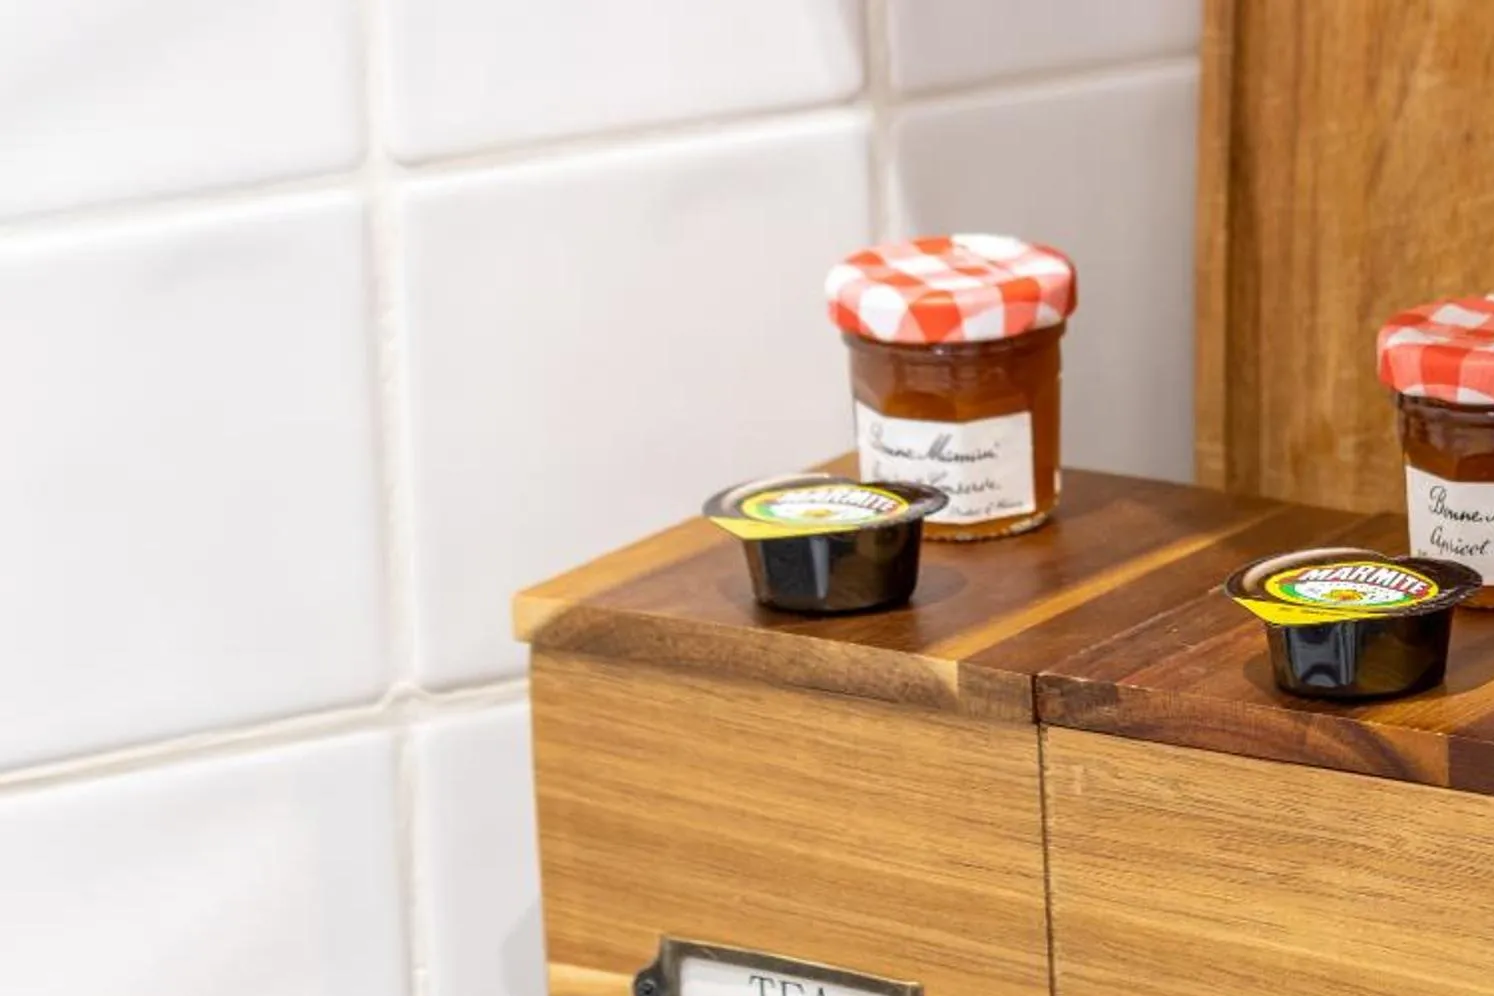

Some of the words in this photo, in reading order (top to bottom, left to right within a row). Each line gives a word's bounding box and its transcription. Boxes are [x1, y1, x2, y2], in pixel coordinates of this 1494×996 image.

[1429, 486, 1483, 521] Bonne
[1430, 526, 1490, 557] Apricot
[1303, 566, 1428, 595] MARMITE
